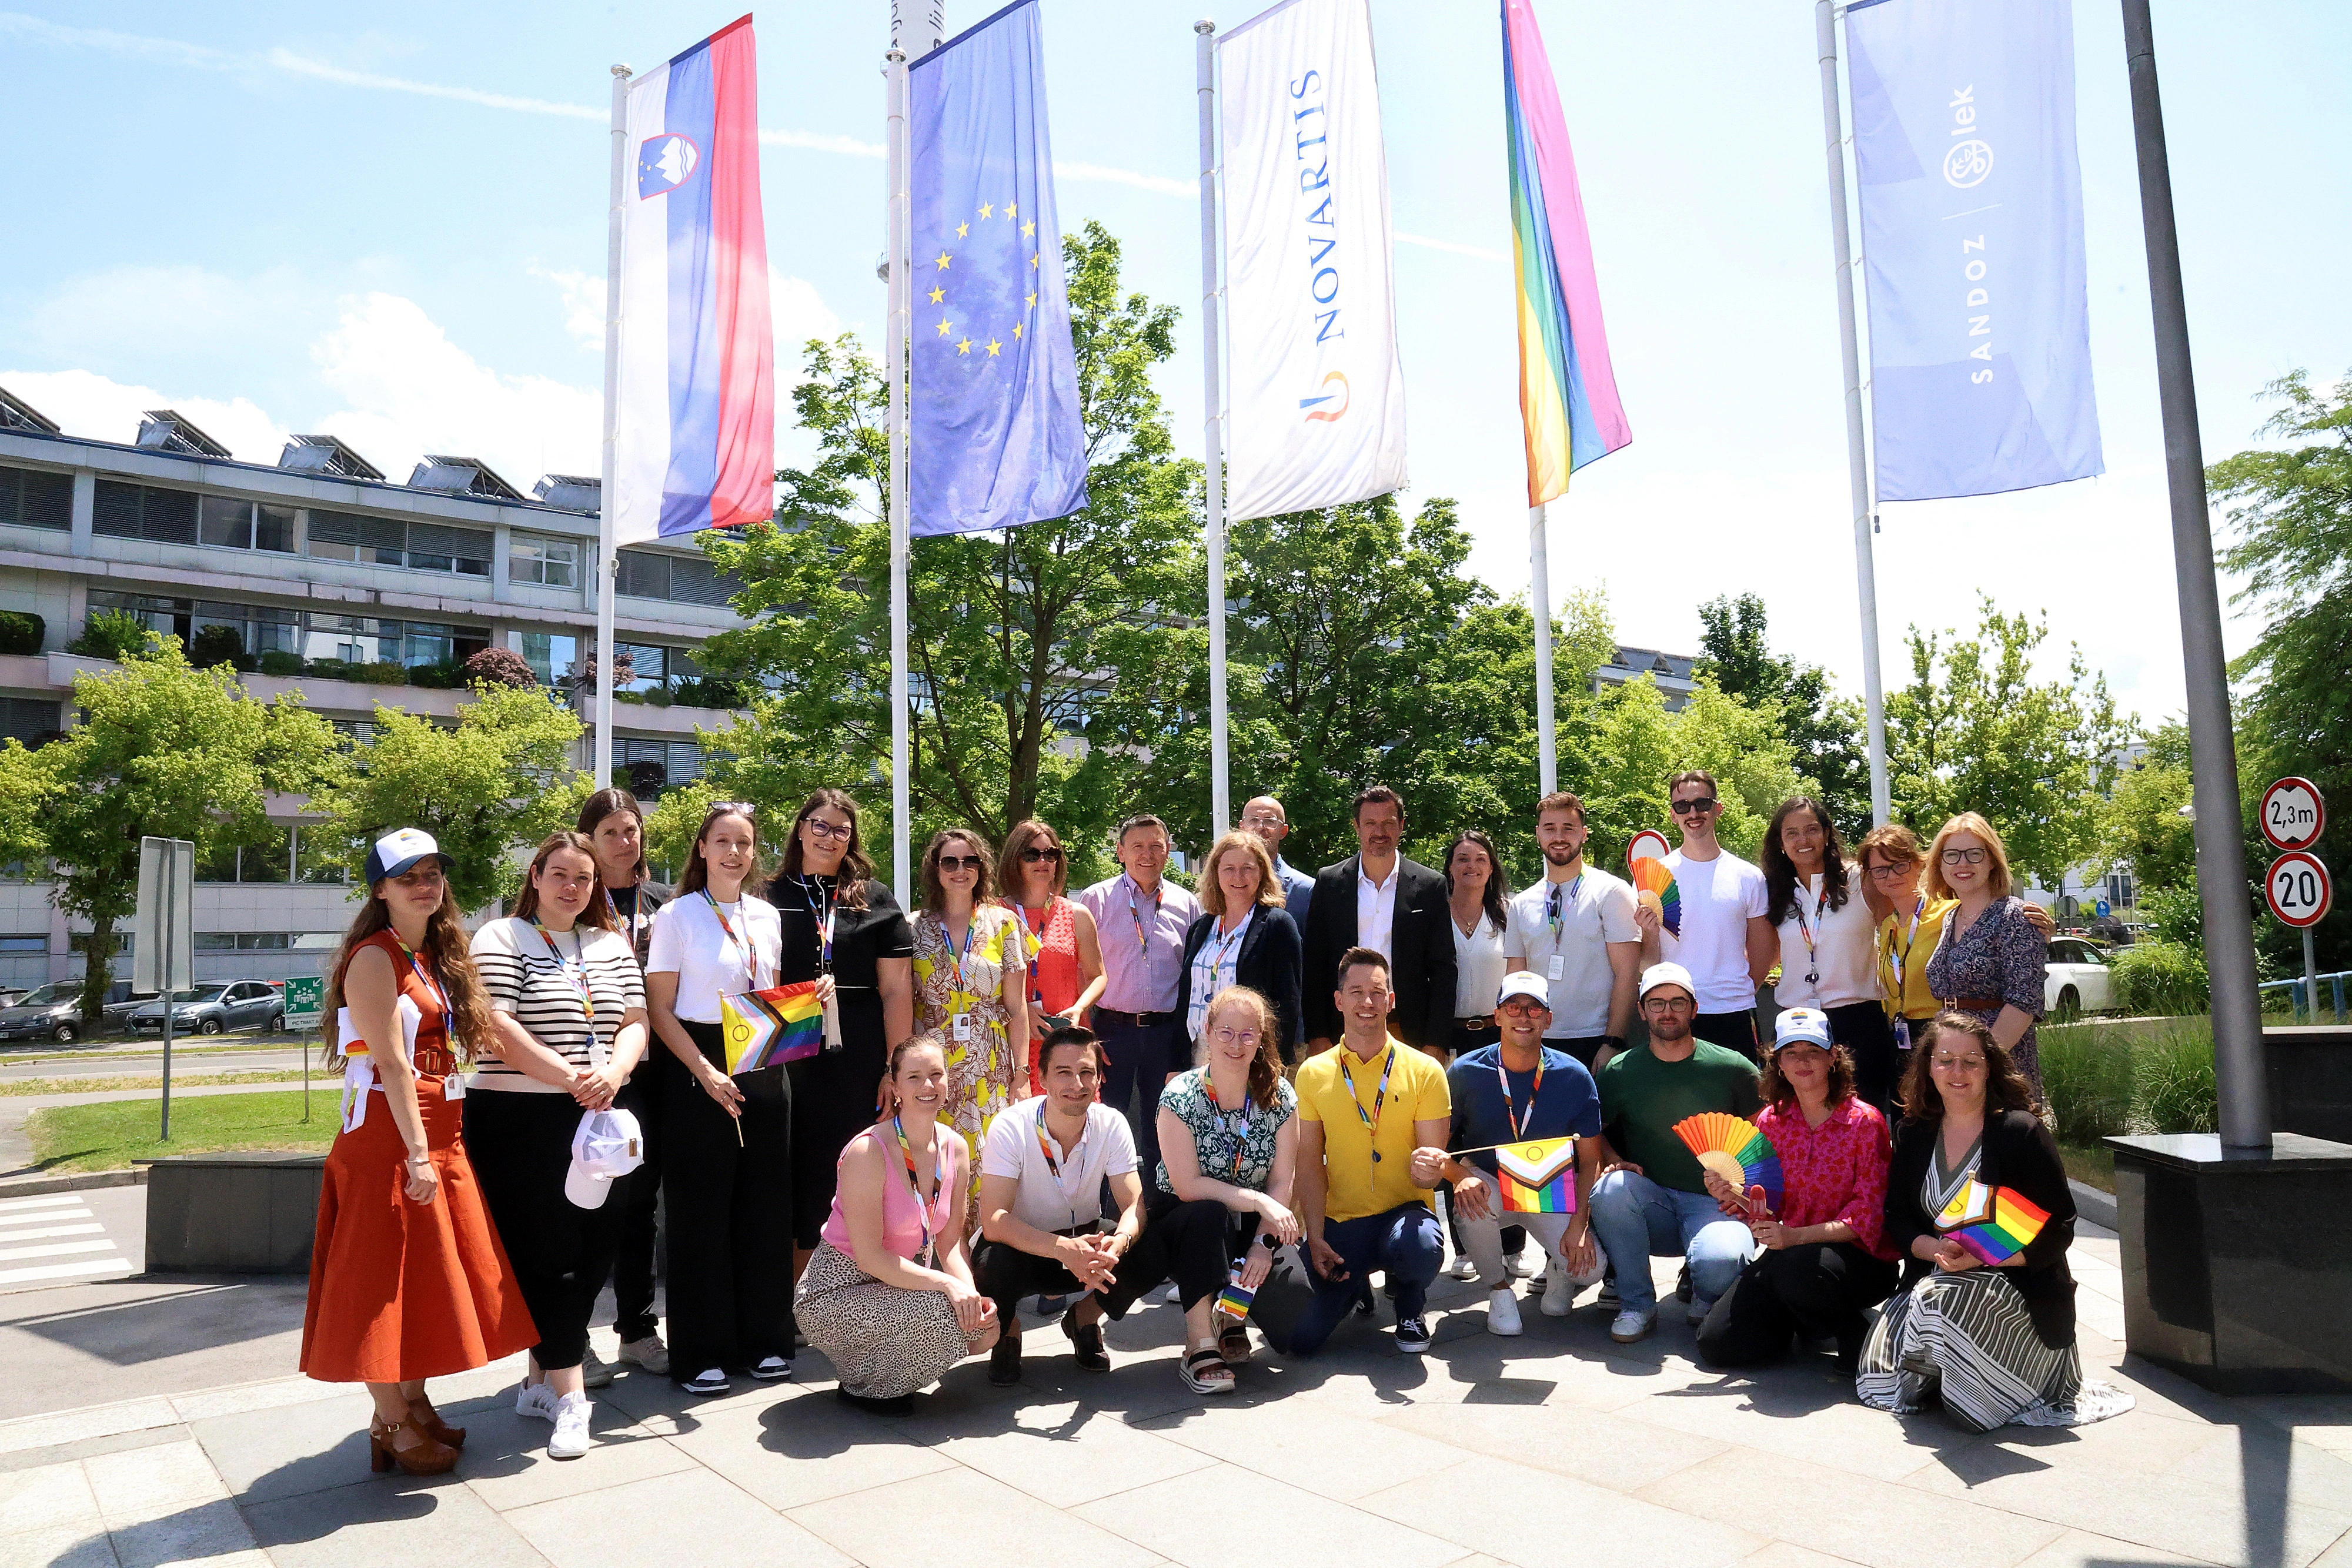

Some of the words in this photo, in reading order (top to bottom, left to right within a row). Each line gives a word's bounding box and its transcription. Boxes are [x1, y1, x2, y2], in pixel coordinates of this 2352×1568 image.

[1949, 83, 1977, 137] lek
[1290, 69, 1344, 346] NOVARTIS
[1963, 234, 1993, 385] SANDOZ
[2278, 871, 2316, 907] 20
